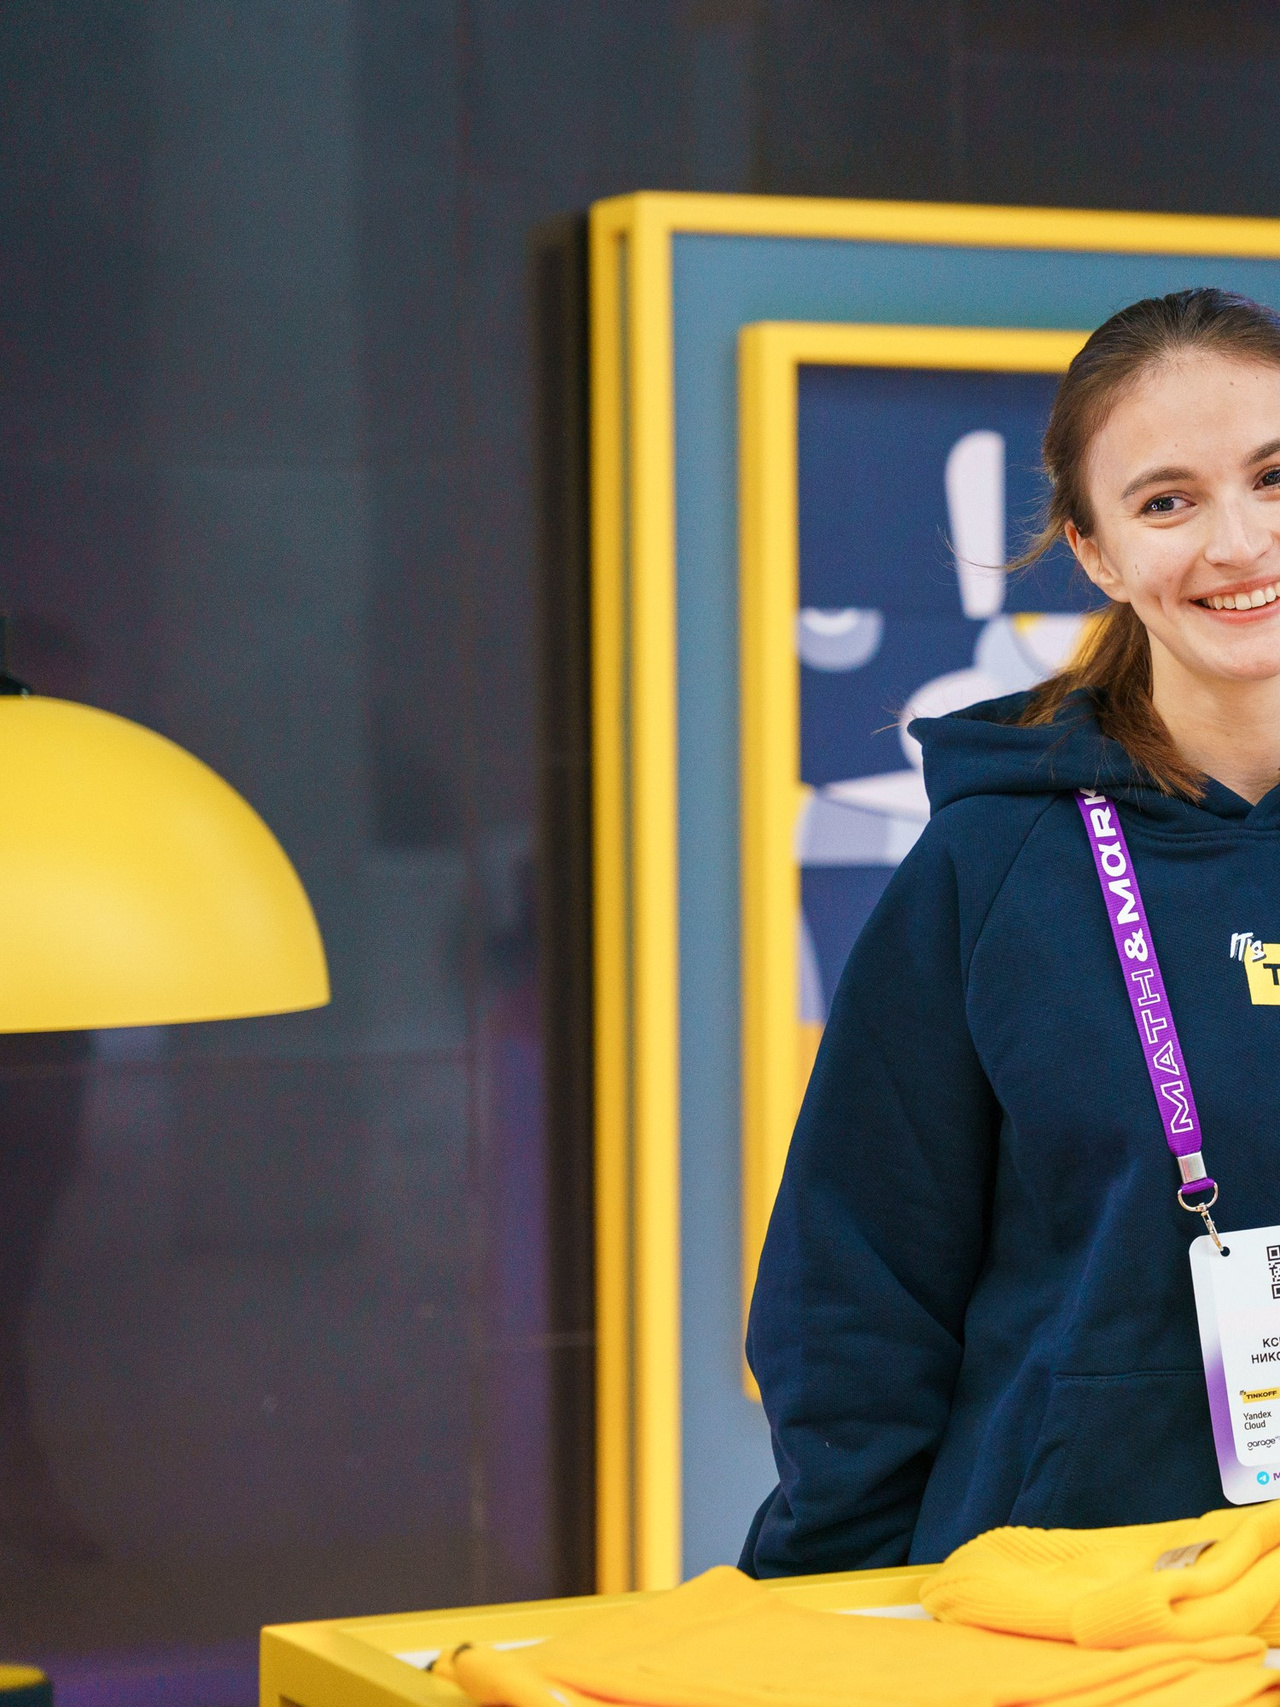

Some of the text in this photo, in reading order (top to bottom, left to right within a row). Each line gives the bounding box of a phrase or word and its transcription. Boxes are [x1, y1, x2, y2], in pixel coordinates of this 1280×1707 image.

[1124, 928, 1149, 962] &
[1131, 968, 1194, 1134] MATH
[1246, 1390, 1278, 1400] TINKOFF
[1243, 1410, 1272, 1421] Yandex
[1244, 1420, 1267, 1431] Cloud
[1247, 1438, 1276, 1451] garage
